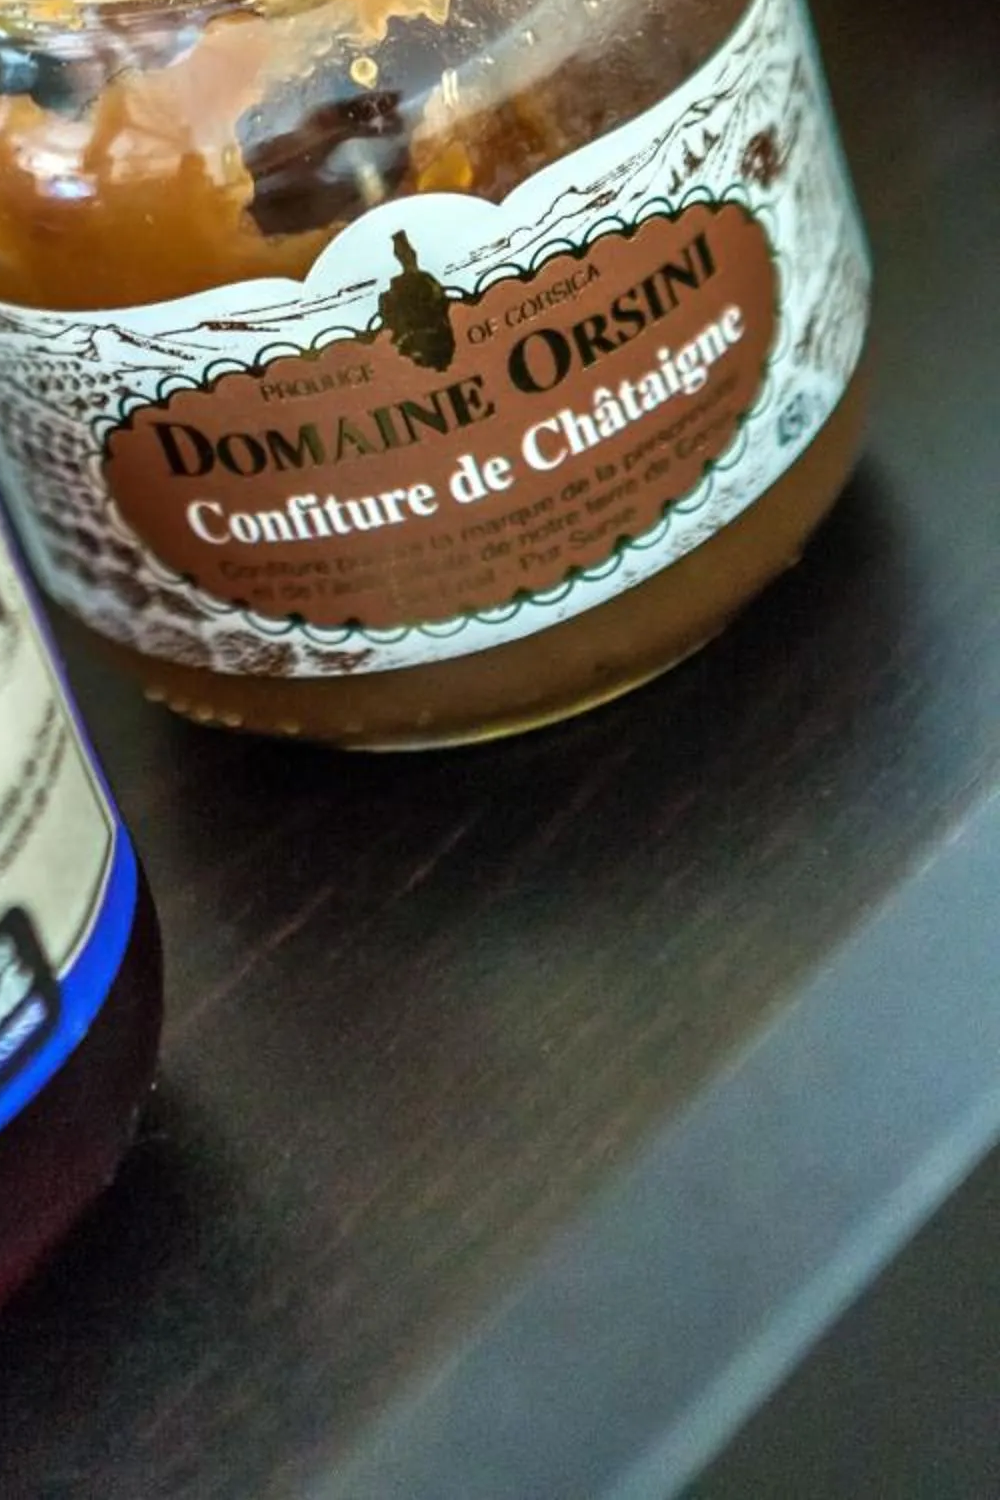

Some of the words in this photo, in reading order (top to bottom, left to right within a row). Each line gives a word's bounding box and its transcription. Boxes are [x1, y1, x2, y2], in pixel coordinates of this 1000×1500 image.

[149, 375, 496, 477] DOMAINE
[507, 231, 718, 395] ORSINI
[186, 482, 440, 545] Confiture
[450, 452, 515, 504] de
[521, 303, 747, 472] Châtaigne
[466, 325, 500, 346] OF
[505, 263, 602, 329] CORSICA
